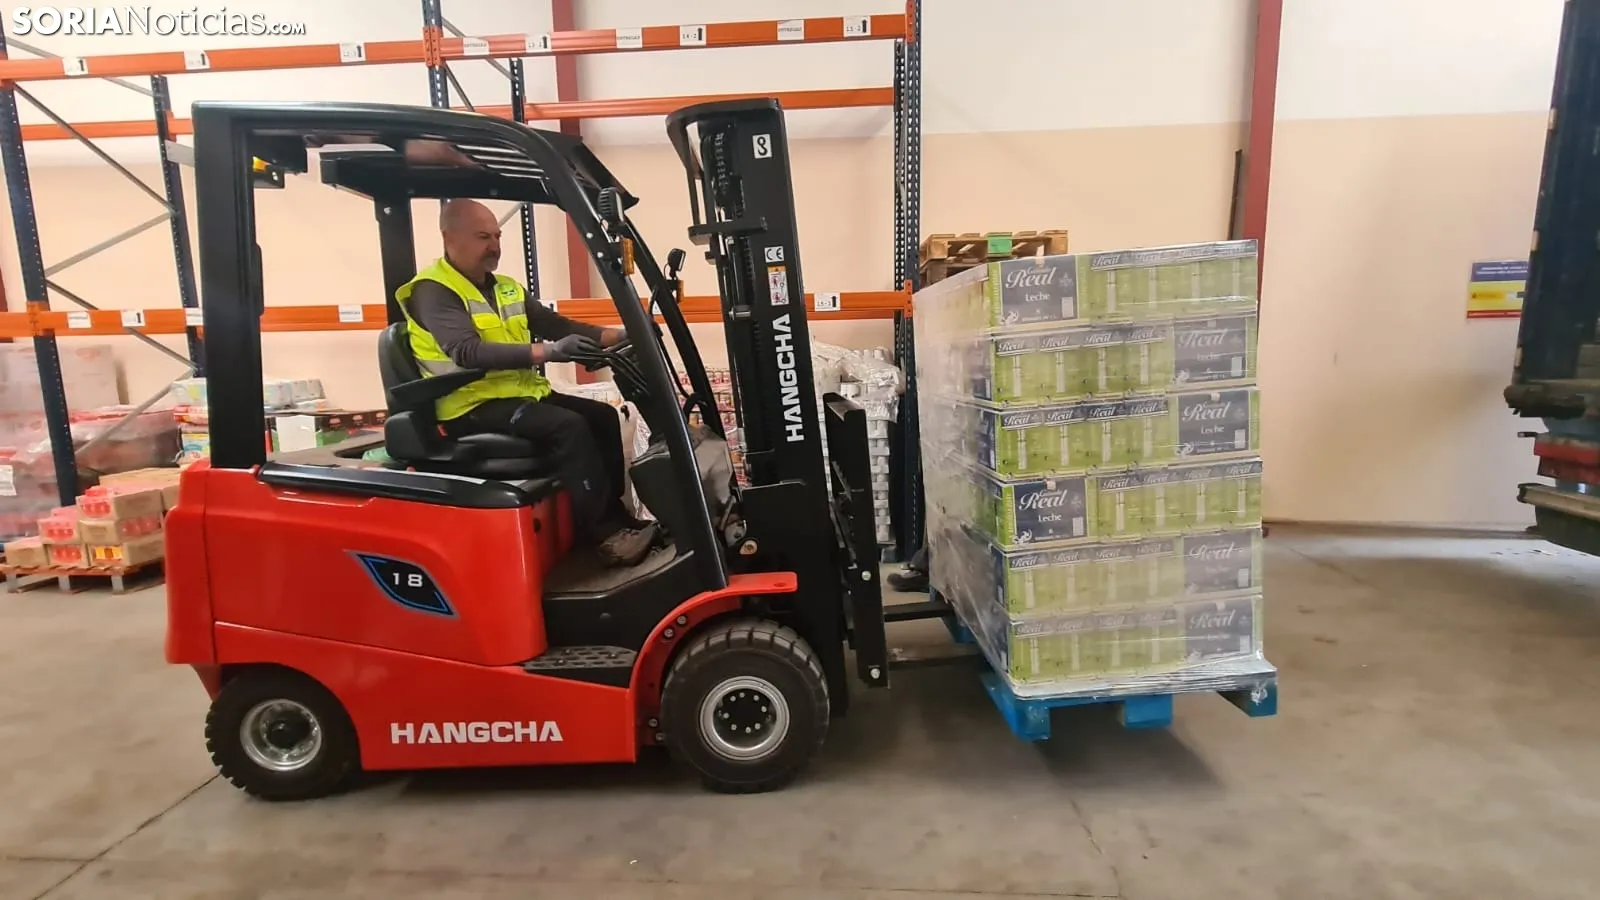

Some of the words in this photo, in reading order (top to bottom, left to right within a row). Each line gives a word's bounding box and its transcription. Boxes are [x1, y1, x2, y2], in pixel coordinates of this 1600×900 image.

[1005, 266, 1057, 289] Real
[1025, 291, 1050, 302] Leche
[772, 313, 804, 442] HANGCHA
[1004, 414, 1031, 426] Real
[1048, 410, 1075, 422] Real
[1090, 406, 1117, 418] Real
[1182, 401, 1231, 422] Real
[1019, 489, 1068, 510] Real
[1038, 513, 1063, 523] Leche
[390, 721, 564, 744] HANGCHA
